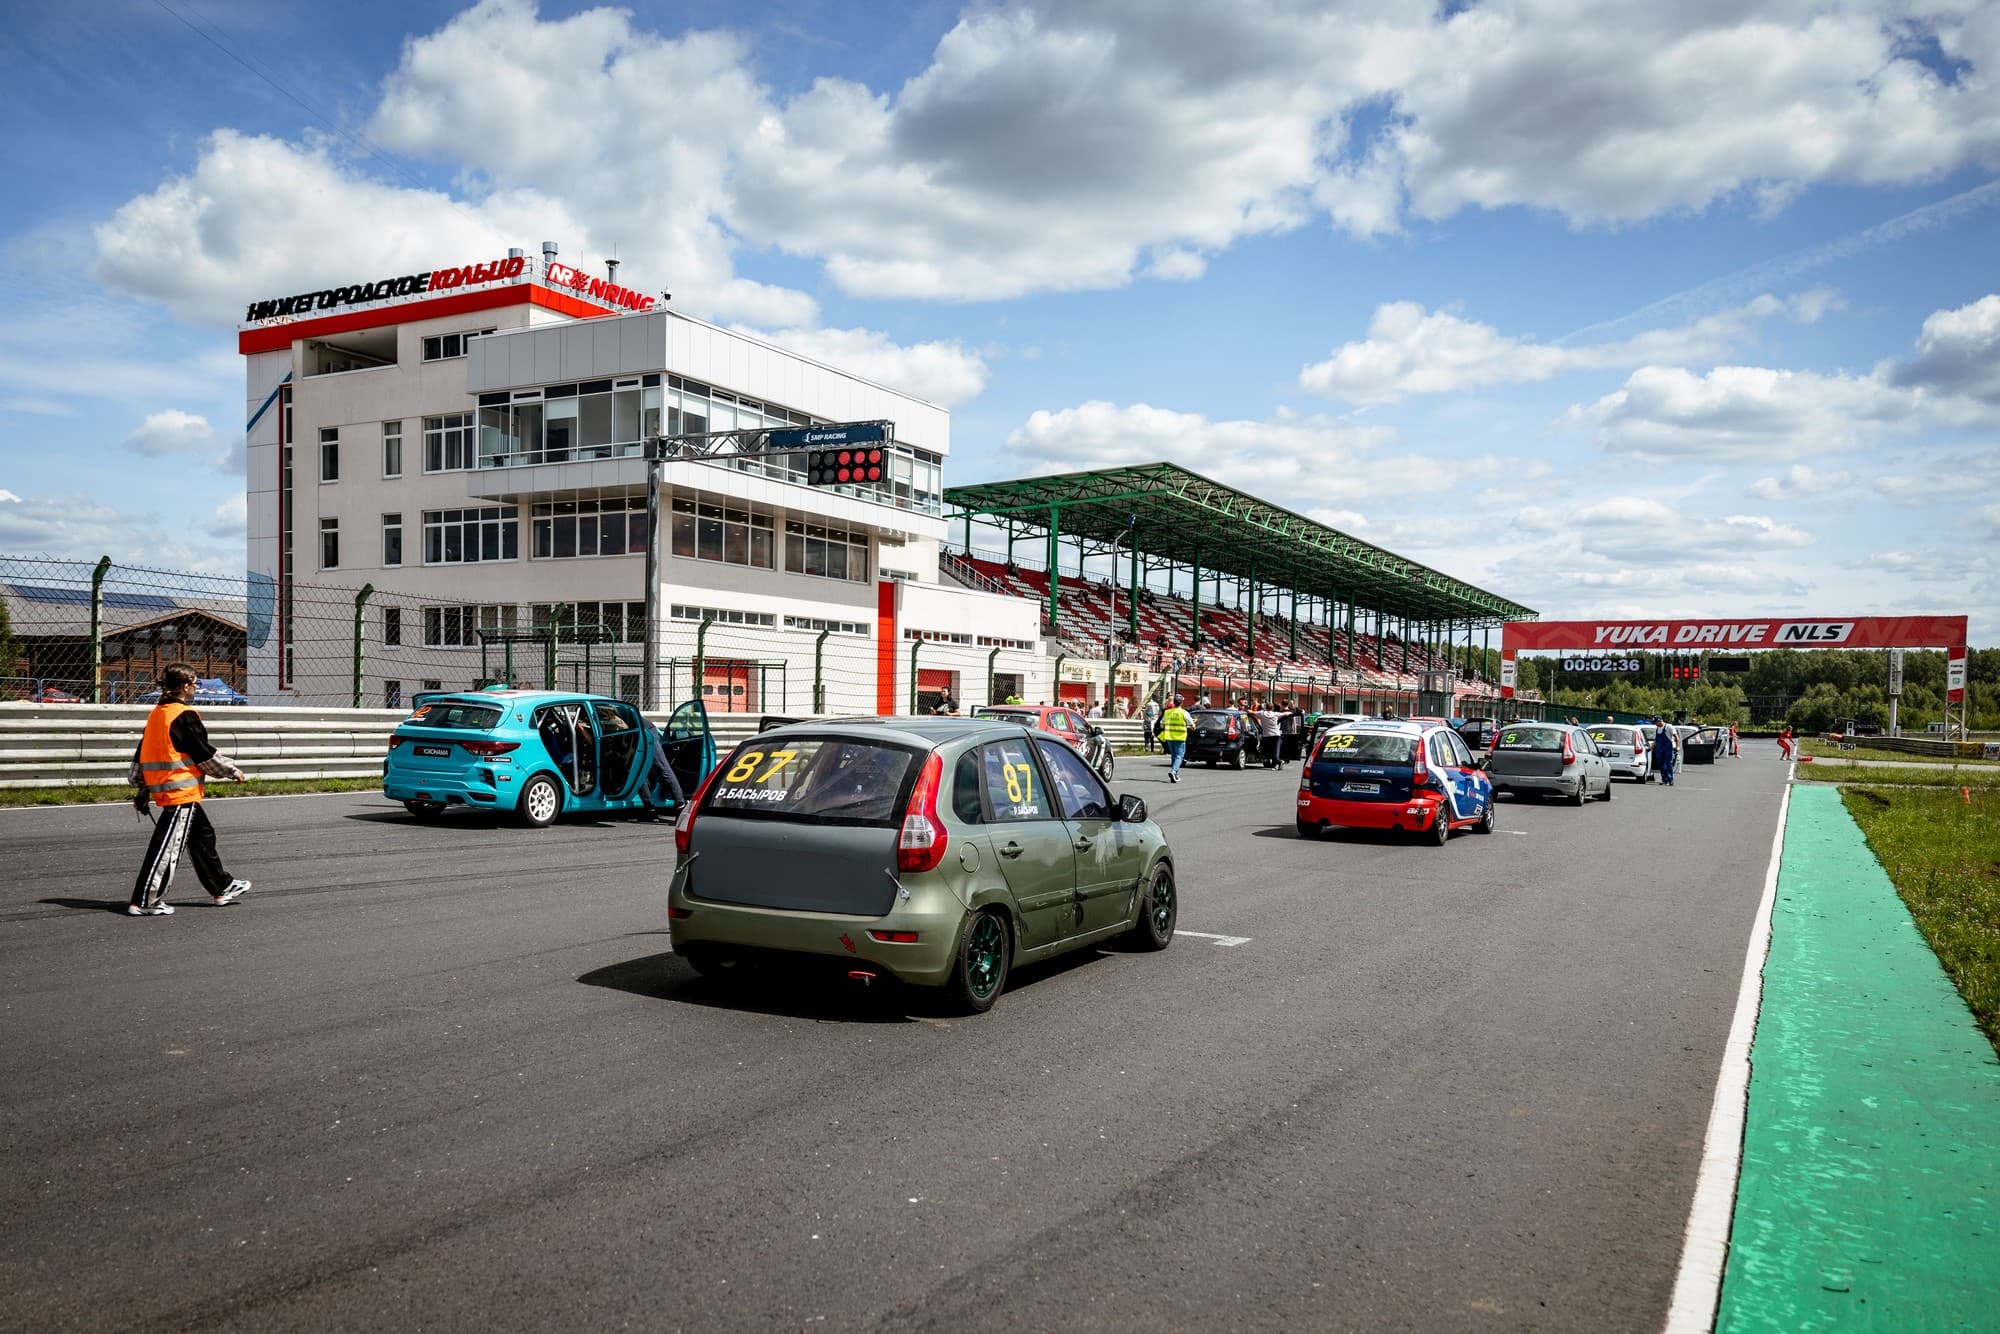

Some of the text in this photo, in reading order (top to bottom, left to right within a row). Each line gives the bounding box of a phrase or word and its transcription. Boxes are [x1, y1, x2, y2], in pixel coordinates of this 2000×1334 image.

[588, 278, 655, 312] NRING
[824, 432, 847, 440] RACING
[1594, 624, 1843, 643] YUKA DRIVE NLS
[1564, 659, 1640, 671] 00:02:36
[1325, 734, 1355, 748] 23
[1506, 733, 1517, 743] 5
[726, 751, 797, 783] 87
[1003, 763, 1031, 803] 87
[716, 788, 787, 801] Р.БАСЫРОВ
